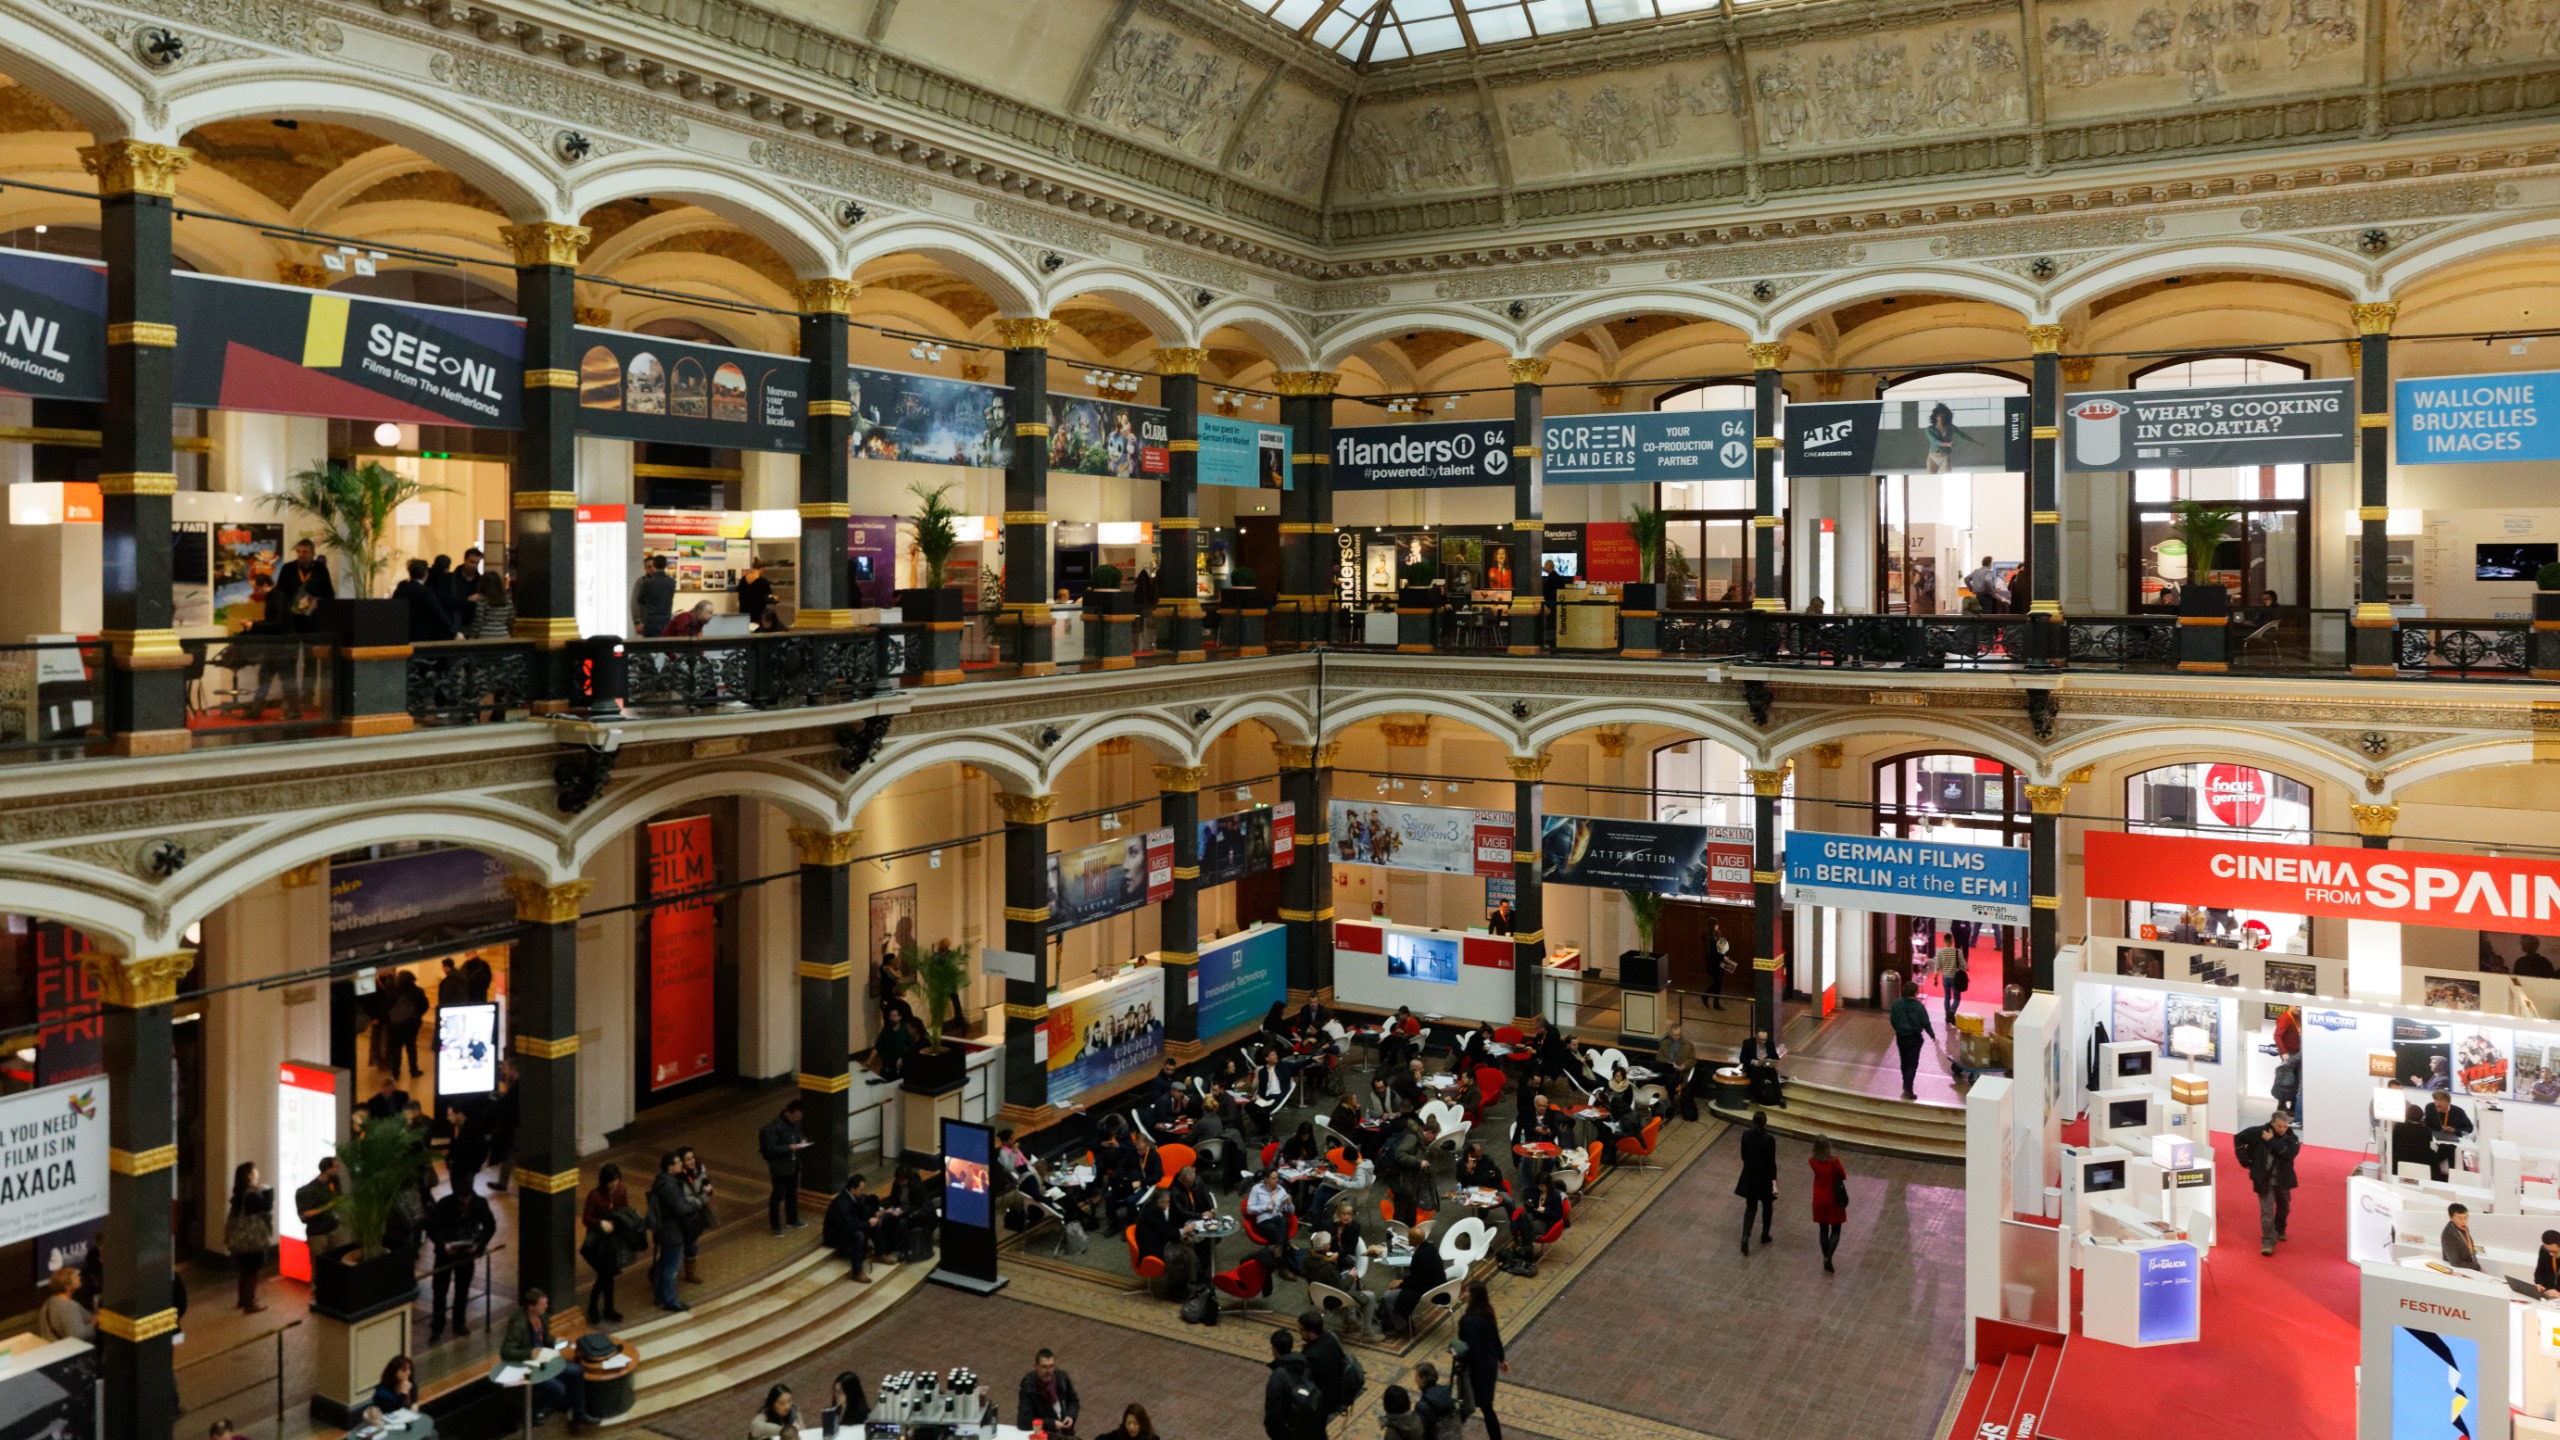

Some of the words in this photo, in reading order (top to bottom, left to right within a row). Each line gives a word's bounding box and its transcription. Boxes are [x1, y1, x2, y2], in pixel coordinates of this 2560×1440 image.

[5, 309, 70, 363] NL
[367, 323, 441, 376] SEE
[459, 358, 503, 400] NL
[361, 357, 392, 378] Films
[393, 368, 418, 387] from
[420, 378, 440, 395] The
[440, 387, 500, 417] Netherlands
[766, 386, 798, 398] Morocco
[2413, 386, 2535, 409] WALLONIE
[2011, 412, 2020, 422] US
[2082, 402, 2113, 415] 119
[2136, 401, 2224, 421] WHAT'S
[2229, 398, 2340, 417] COOKING
[766, 415, 796, 427] location
[1721, 421, 1746, 437] G4
[2137, 424, 2162, 439] IN
[2168, 416, 2283, 437] CROATIA?
[2412, 408, 2539, 431] BRUXELLES
[1142, 421, 1168, 441] CLARA
[1484, 430, 1506, 446] G4
[1546, 425, 1636, 450] SCREEN
[1666, 427, 1690, 437] YOUR
[1804, 422, 1852, 445] ARG
[2011, 422, 2020, 441] VISIT
[1643, 440, 1714, 452] CO-PRODUCTION
[2427, 432, 2523, 452] IMAGES
[1546, 451, 1636, 467] FLANDERS
[1657, 456, 1699, 466] PARTNER
[1364, 463, 1475, 481] #poweredbytalent
[2212, 776, 2254, 793] focus
[1446, 820, 1459, 842] 3
[650, 827, 694, 859] LUX
[1482, 836, 1508, 849] MGB
[1482, 849, 1505, 861] 105
[1590, 848, 1676, 864] ATTRACTION
[1716, 855, 1745, 868] MGB
[1824, 841, 1913, 867] GERMAN
[1919, 849, 1986, 871] FILMS
[650, 853, 704, 889] FILM
[1718, 869, 1743, 882] 105
[1793, 862, 1811, 879] in
[1816, 864, 1892, 887] BERLIN
[1897, 874, 1917, 890] at
[1922, 873, 1956, 893] the
[1961, 876, 2007, 898] EFM
[2210, 853, 2360, 888] CINEMA
[2305, 888, 2361, 905] FROM
[2365, 864, 2560, 921] SPAIN
[1971, 904, 2007, 917] german
[1995, 911, 2018, 922] films
[11, 1122, 38, 1143] YOU
[43, 1112, 78, 1136] NEED
[4, 1143, 38, 1169] FILM
[44, 1140, 57, 1158] IS
[61, 1134, 76, 1153] IN
[2400, 1298, 2471, 1321] FESTIVAL
